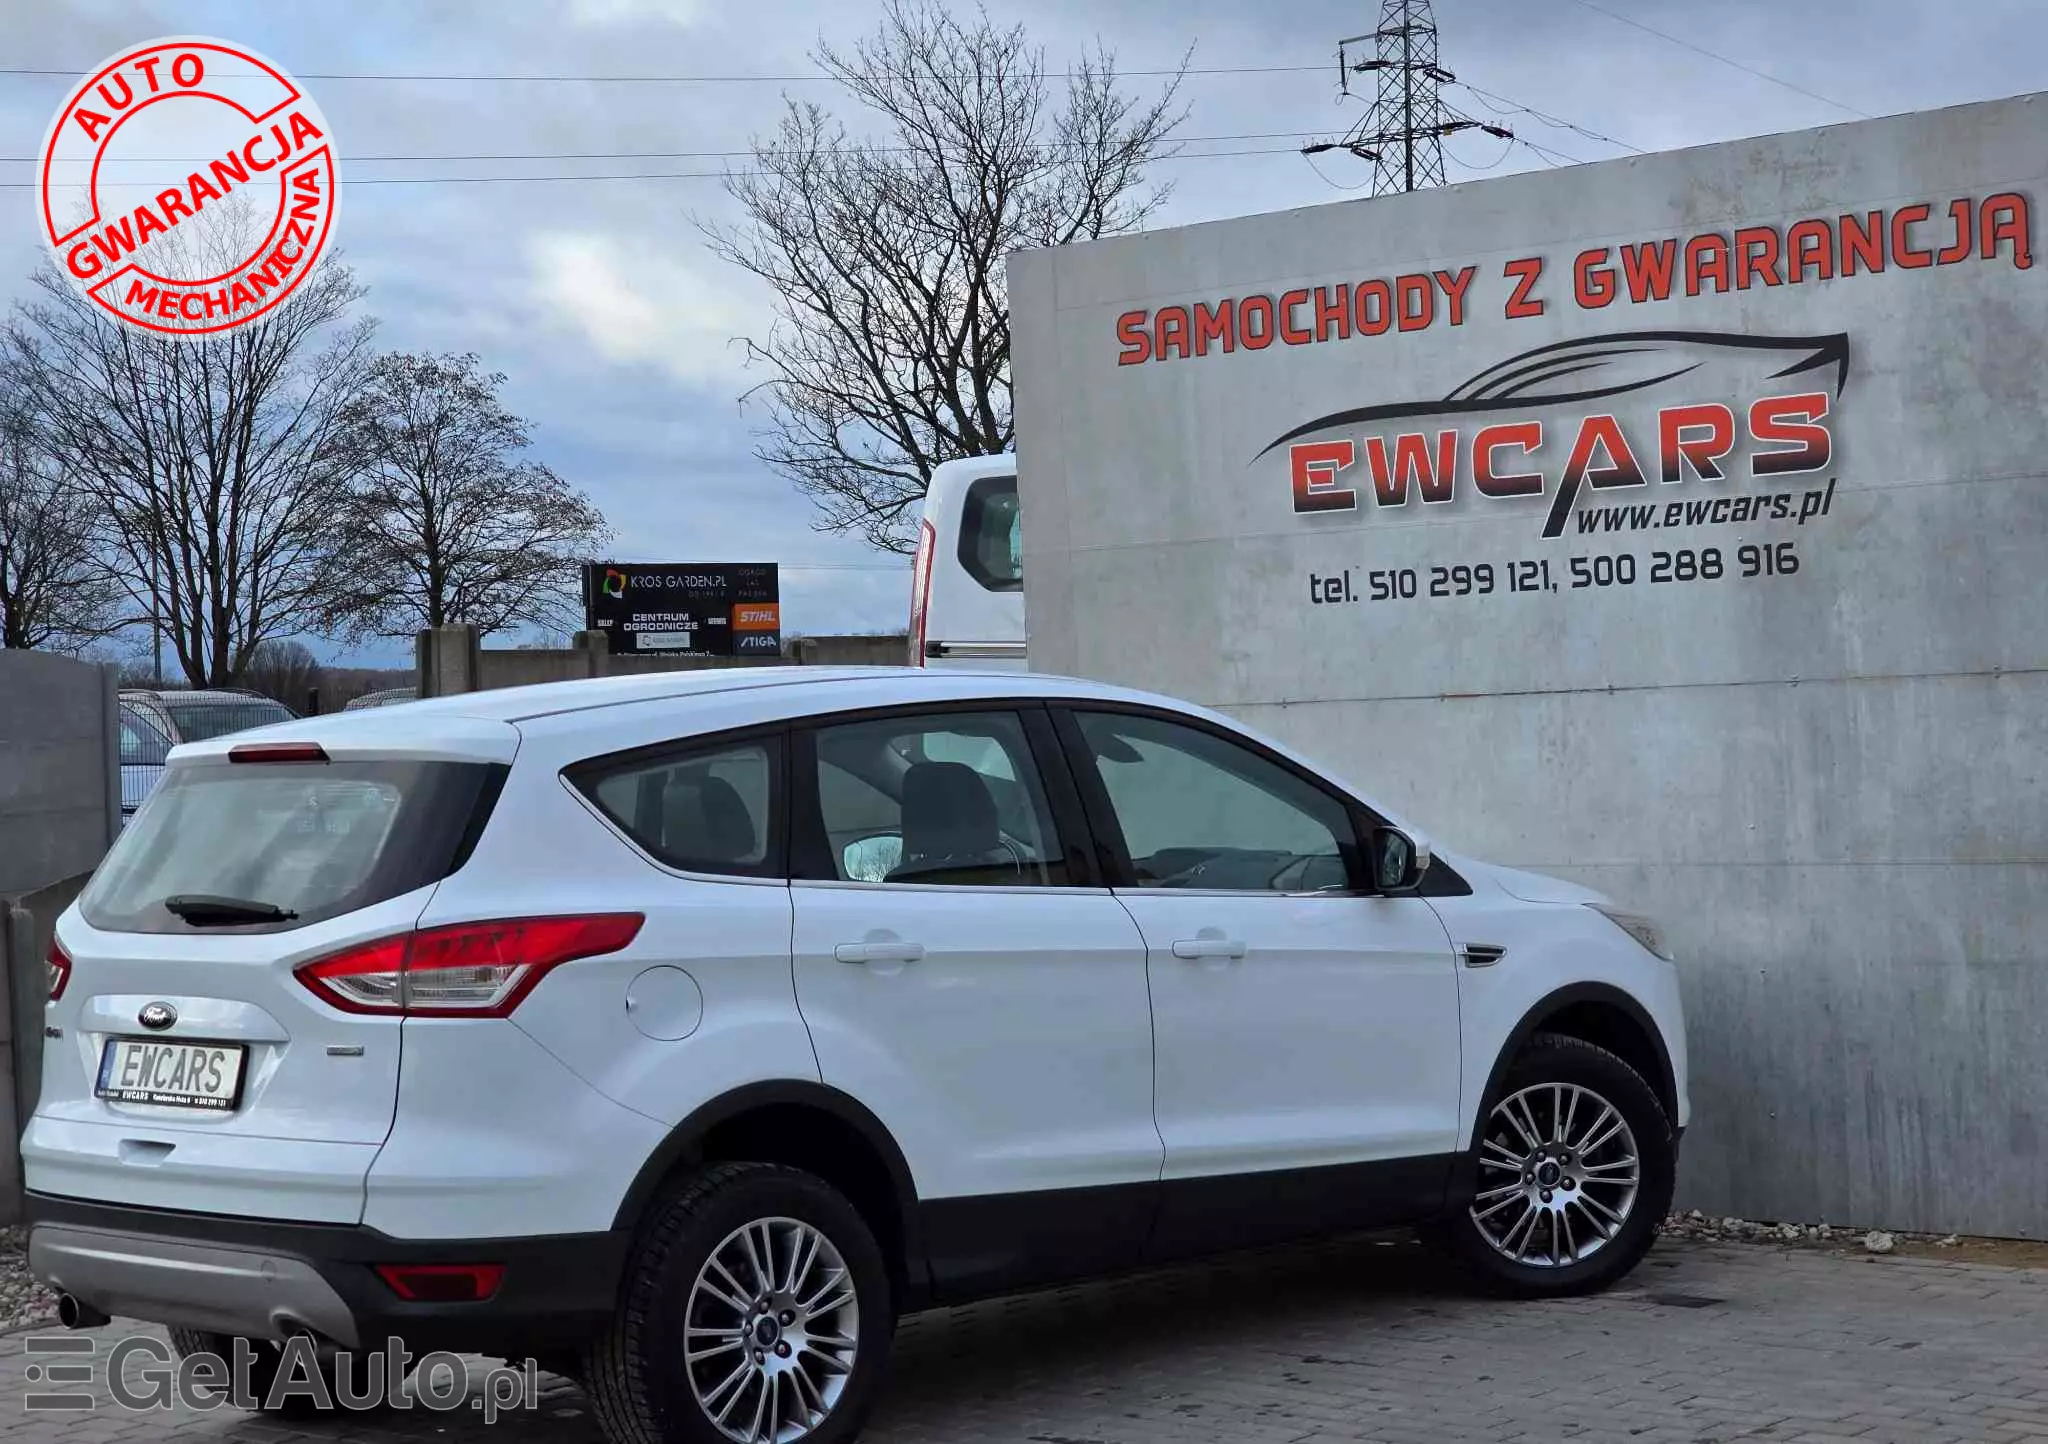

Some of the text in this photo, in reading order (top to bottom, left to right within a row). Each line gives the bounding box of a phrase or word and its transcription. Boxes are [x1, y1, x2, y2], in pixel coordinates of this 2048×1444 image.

[1116, 192, 2034, 367] SAMOCHODY Z GWARANCJĄ
[1289, 391, 1833, 541] EWCARS
[1577, 478, 1836, 535] www.ewcars.pl
[630, 575, 661, 588] KROS
[1310, 542, 1799, 604] tel. 510 299 121, 500 288 916
[623, 622, 699, 631] OGRODNICZE
[632, 613, 689, 622] CENTRUM
[740, 610, 775, 622] STIHL
[121, 1045, 225, 1094] EWCARS
[122, 1090, 149, 1100] EWCARS
